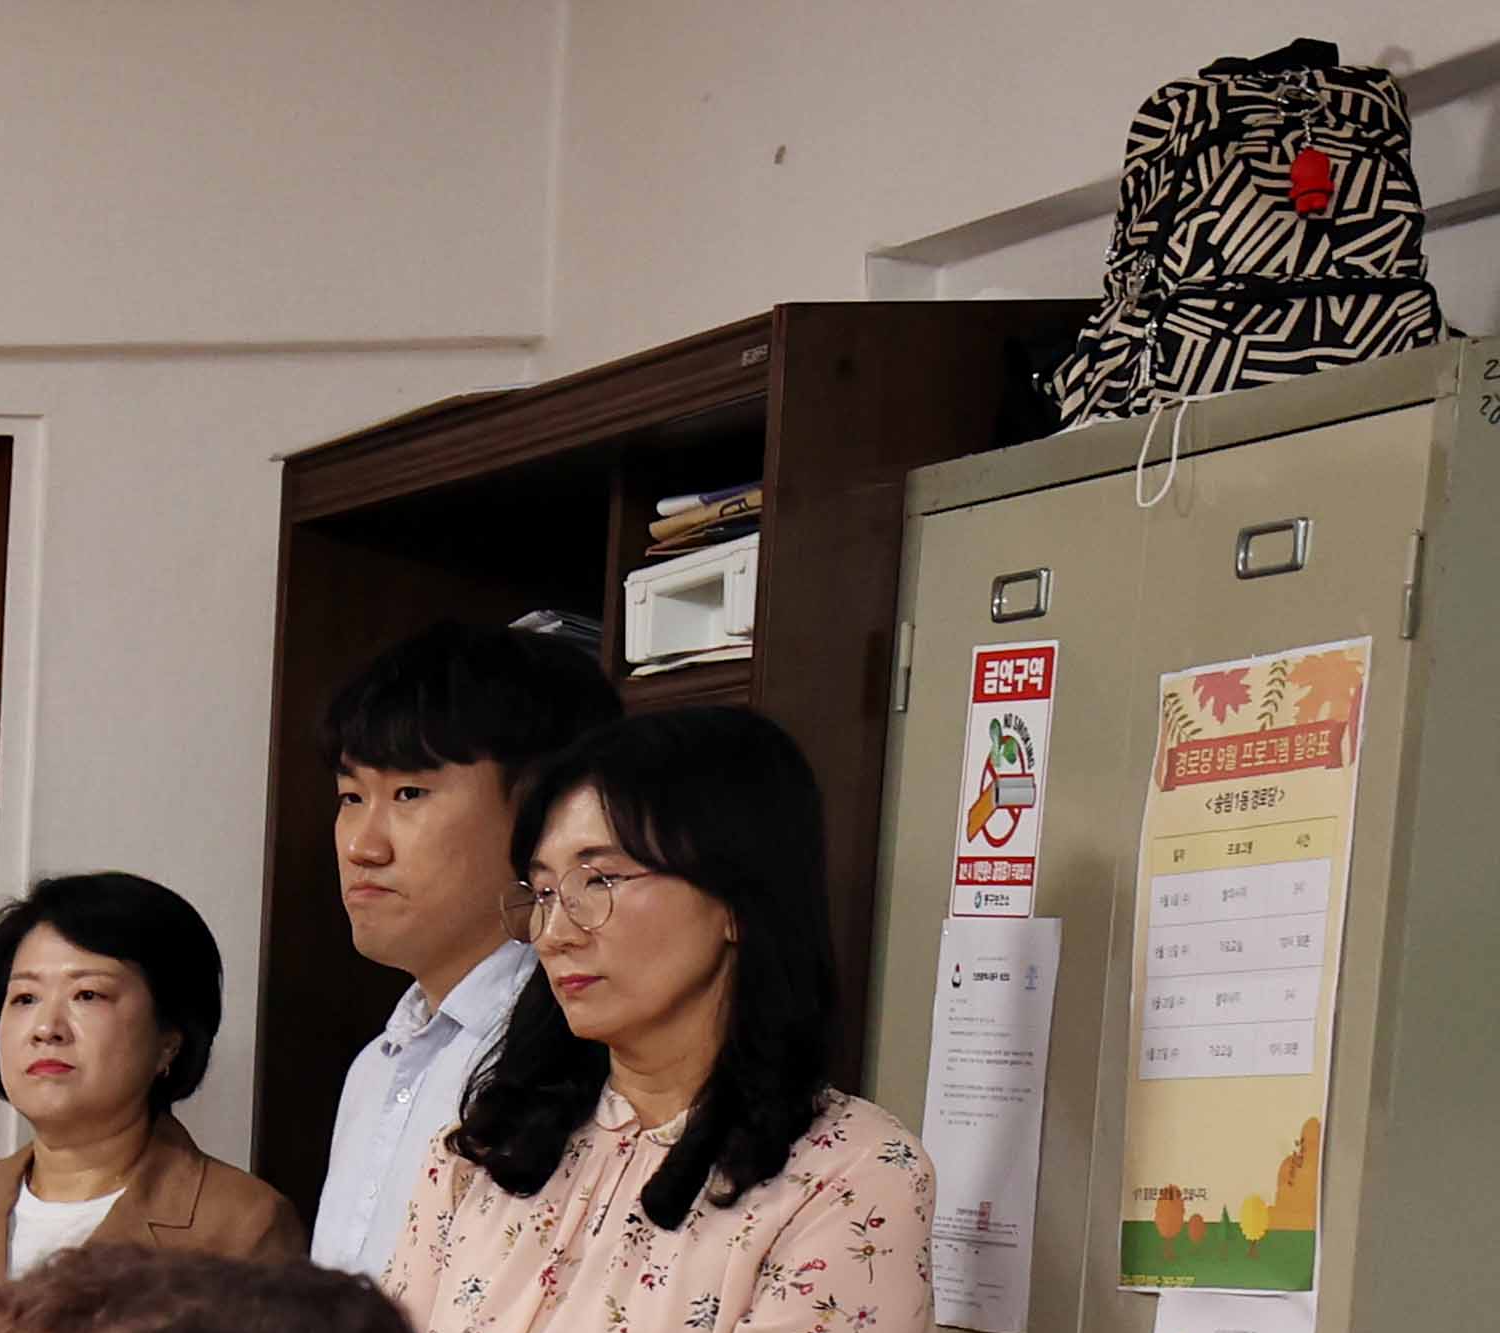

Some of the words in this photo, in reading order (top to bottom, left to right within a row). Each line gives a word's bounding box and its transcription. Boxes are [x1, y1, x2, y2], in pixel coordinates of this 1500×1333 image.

[983, 656, 1046, 696] 금연구역
[1175, 747, 1214, 777] 경로당
[1240, 736, 1290, 768] 프로그램
